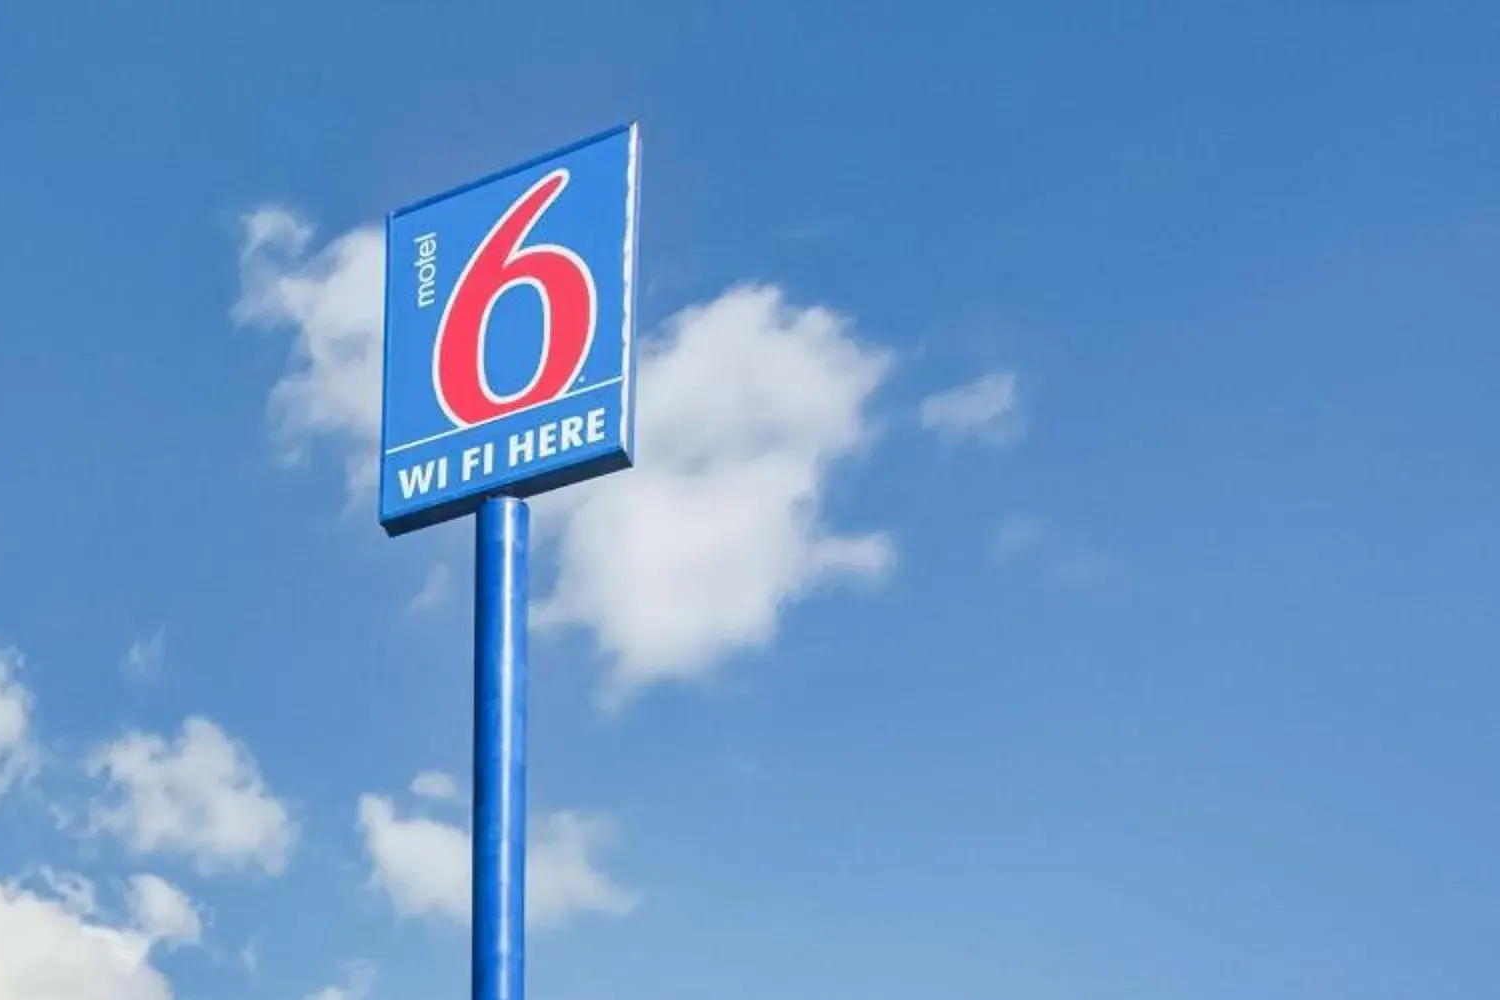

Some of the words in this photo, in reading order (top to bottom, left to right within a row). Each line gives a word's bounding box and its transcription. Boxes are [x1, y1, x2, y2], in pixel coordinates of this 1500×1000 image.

[413, 231, 437, 308] motel
[432, 169, 597, 428] 6
[398, 457, 448, 499] WI
[461, 442, 494, 482] FI
[508, 407, 606, 467] HERE
